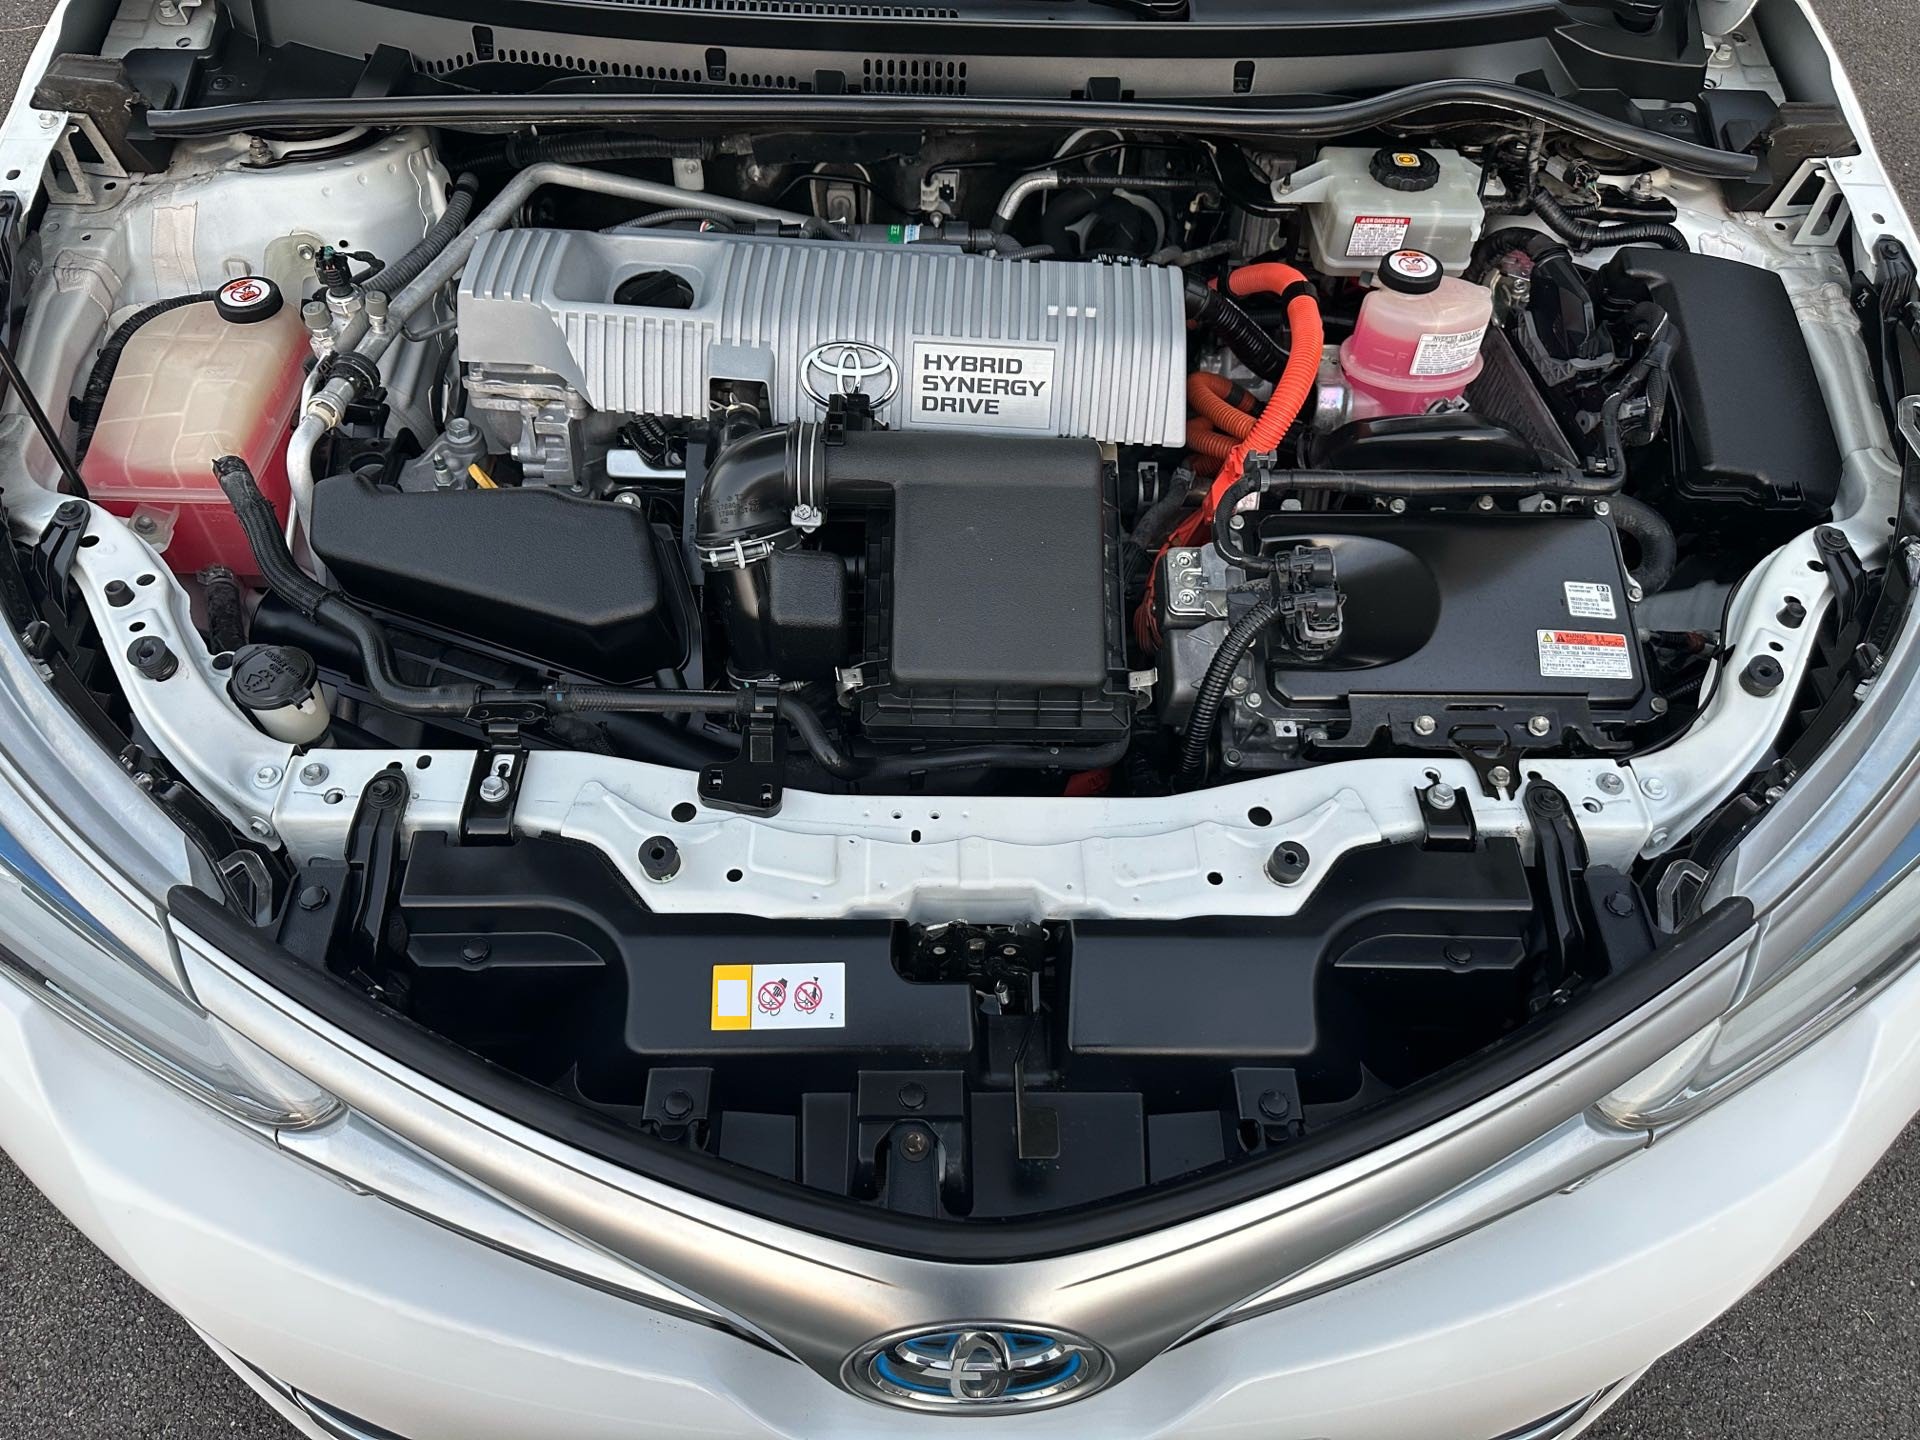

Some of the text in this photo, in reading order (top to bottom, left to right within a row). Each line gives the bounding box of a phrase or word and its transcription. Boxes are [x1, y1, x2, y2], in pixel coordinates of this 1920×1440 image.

[924, 354, 1022, 374] HYBRID
[922, 375, 1046, 397] SYNERGY
[922, 395, 1000, 415] DRIVE
